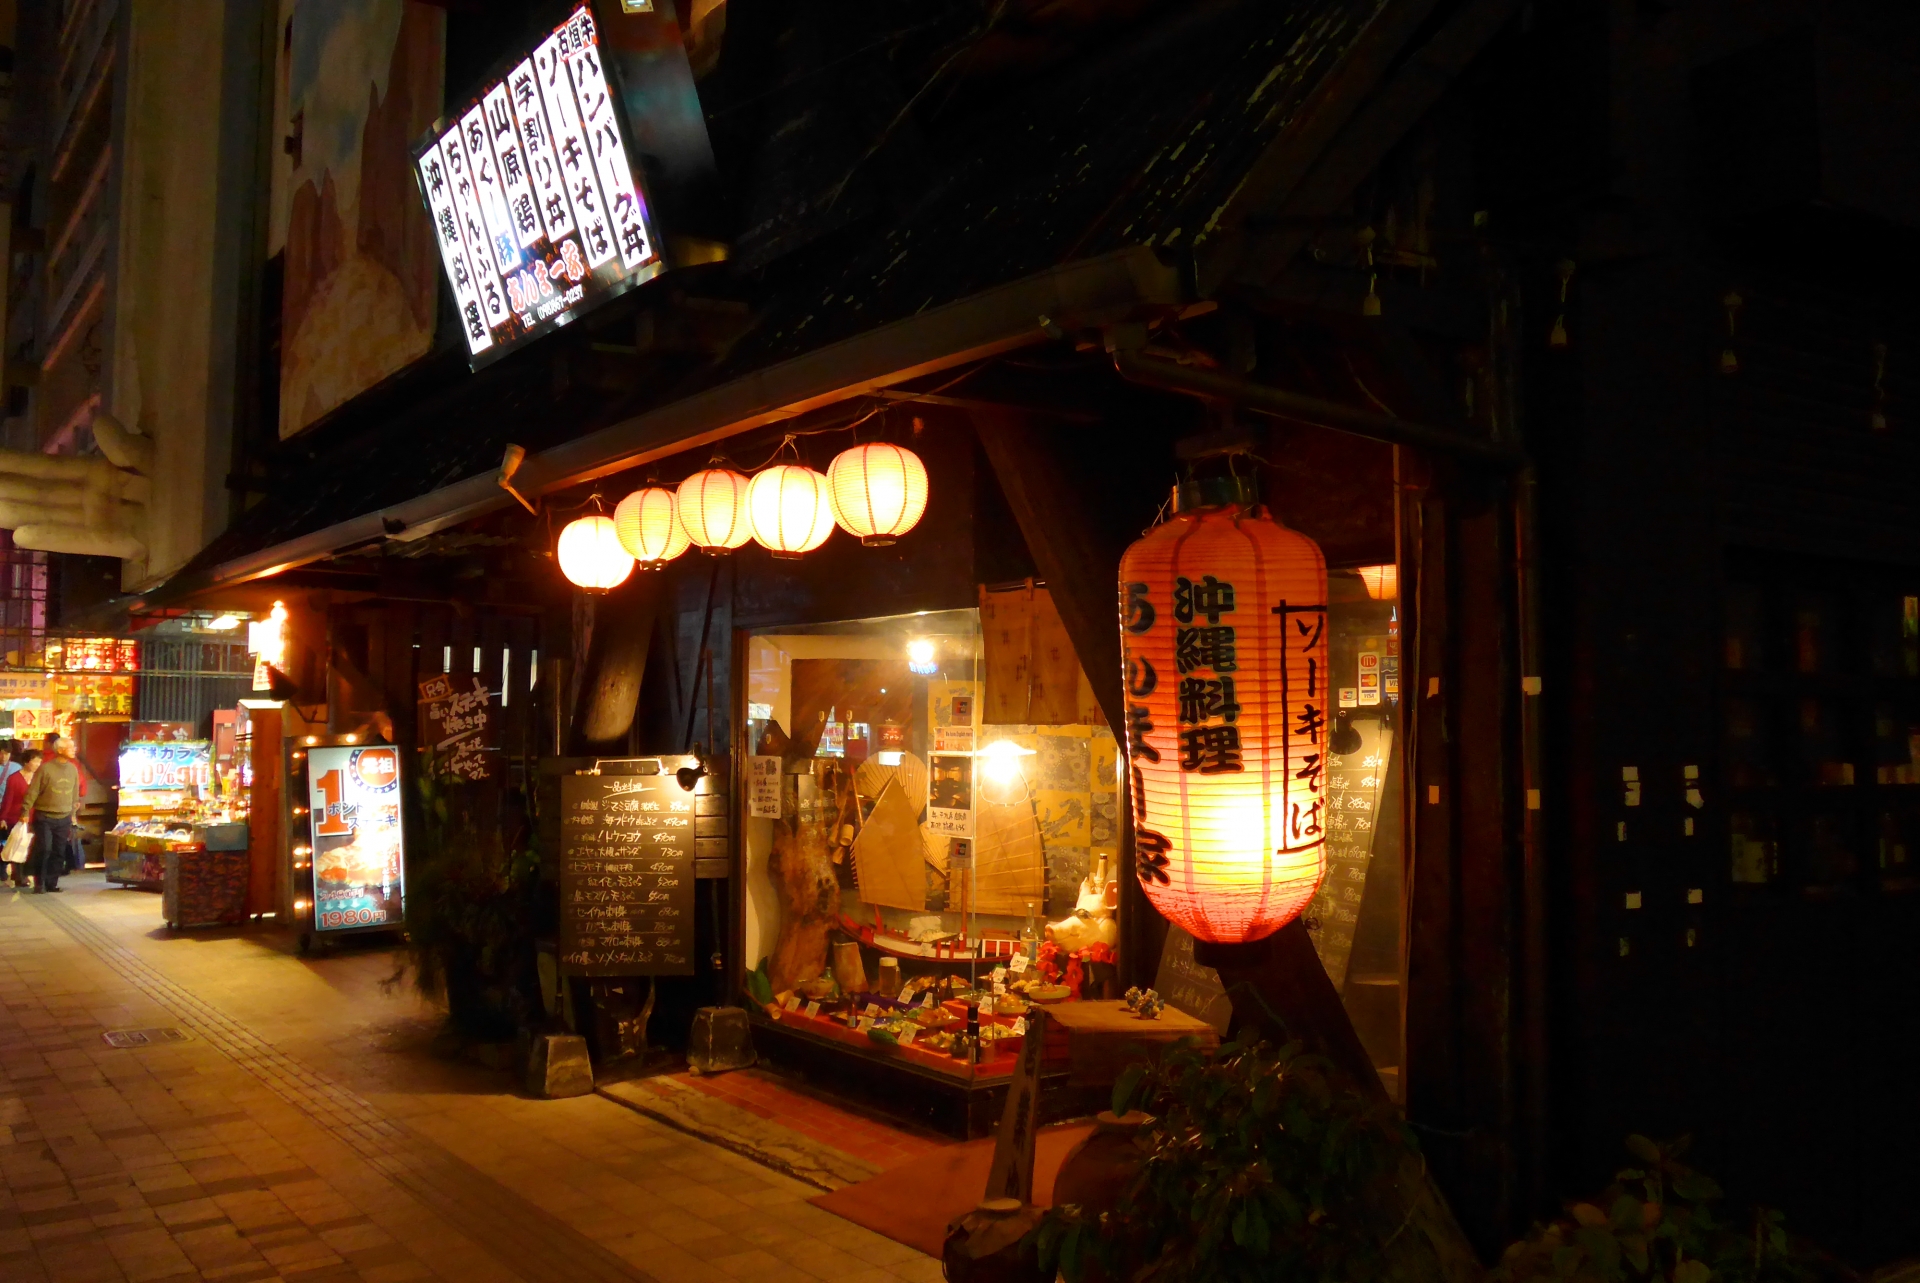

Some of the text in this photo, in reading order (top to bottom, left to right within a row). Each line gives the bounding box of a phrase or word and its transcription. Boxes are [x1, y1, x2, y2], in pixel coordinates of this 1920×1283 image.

[556, 14, 596, 59] 石垣牛
[489, 97, 536, 240] 山原鶏
[514, 71, 566, 232] 学割り丼
[539, 46, 608, 260] ソーキそば
[577, 51, 645, 257] ハンバーグ丼
[506, 241, 585, 313] あんまー家
[521, 313, 536, 328] TEL
[1173, 575, 1244, 776] 沖縄料理
[1290, 614, 1327, 840] ソーキそば
[316, 768, 352, 835] 1
[320, 908, 386, 928] 1980円
